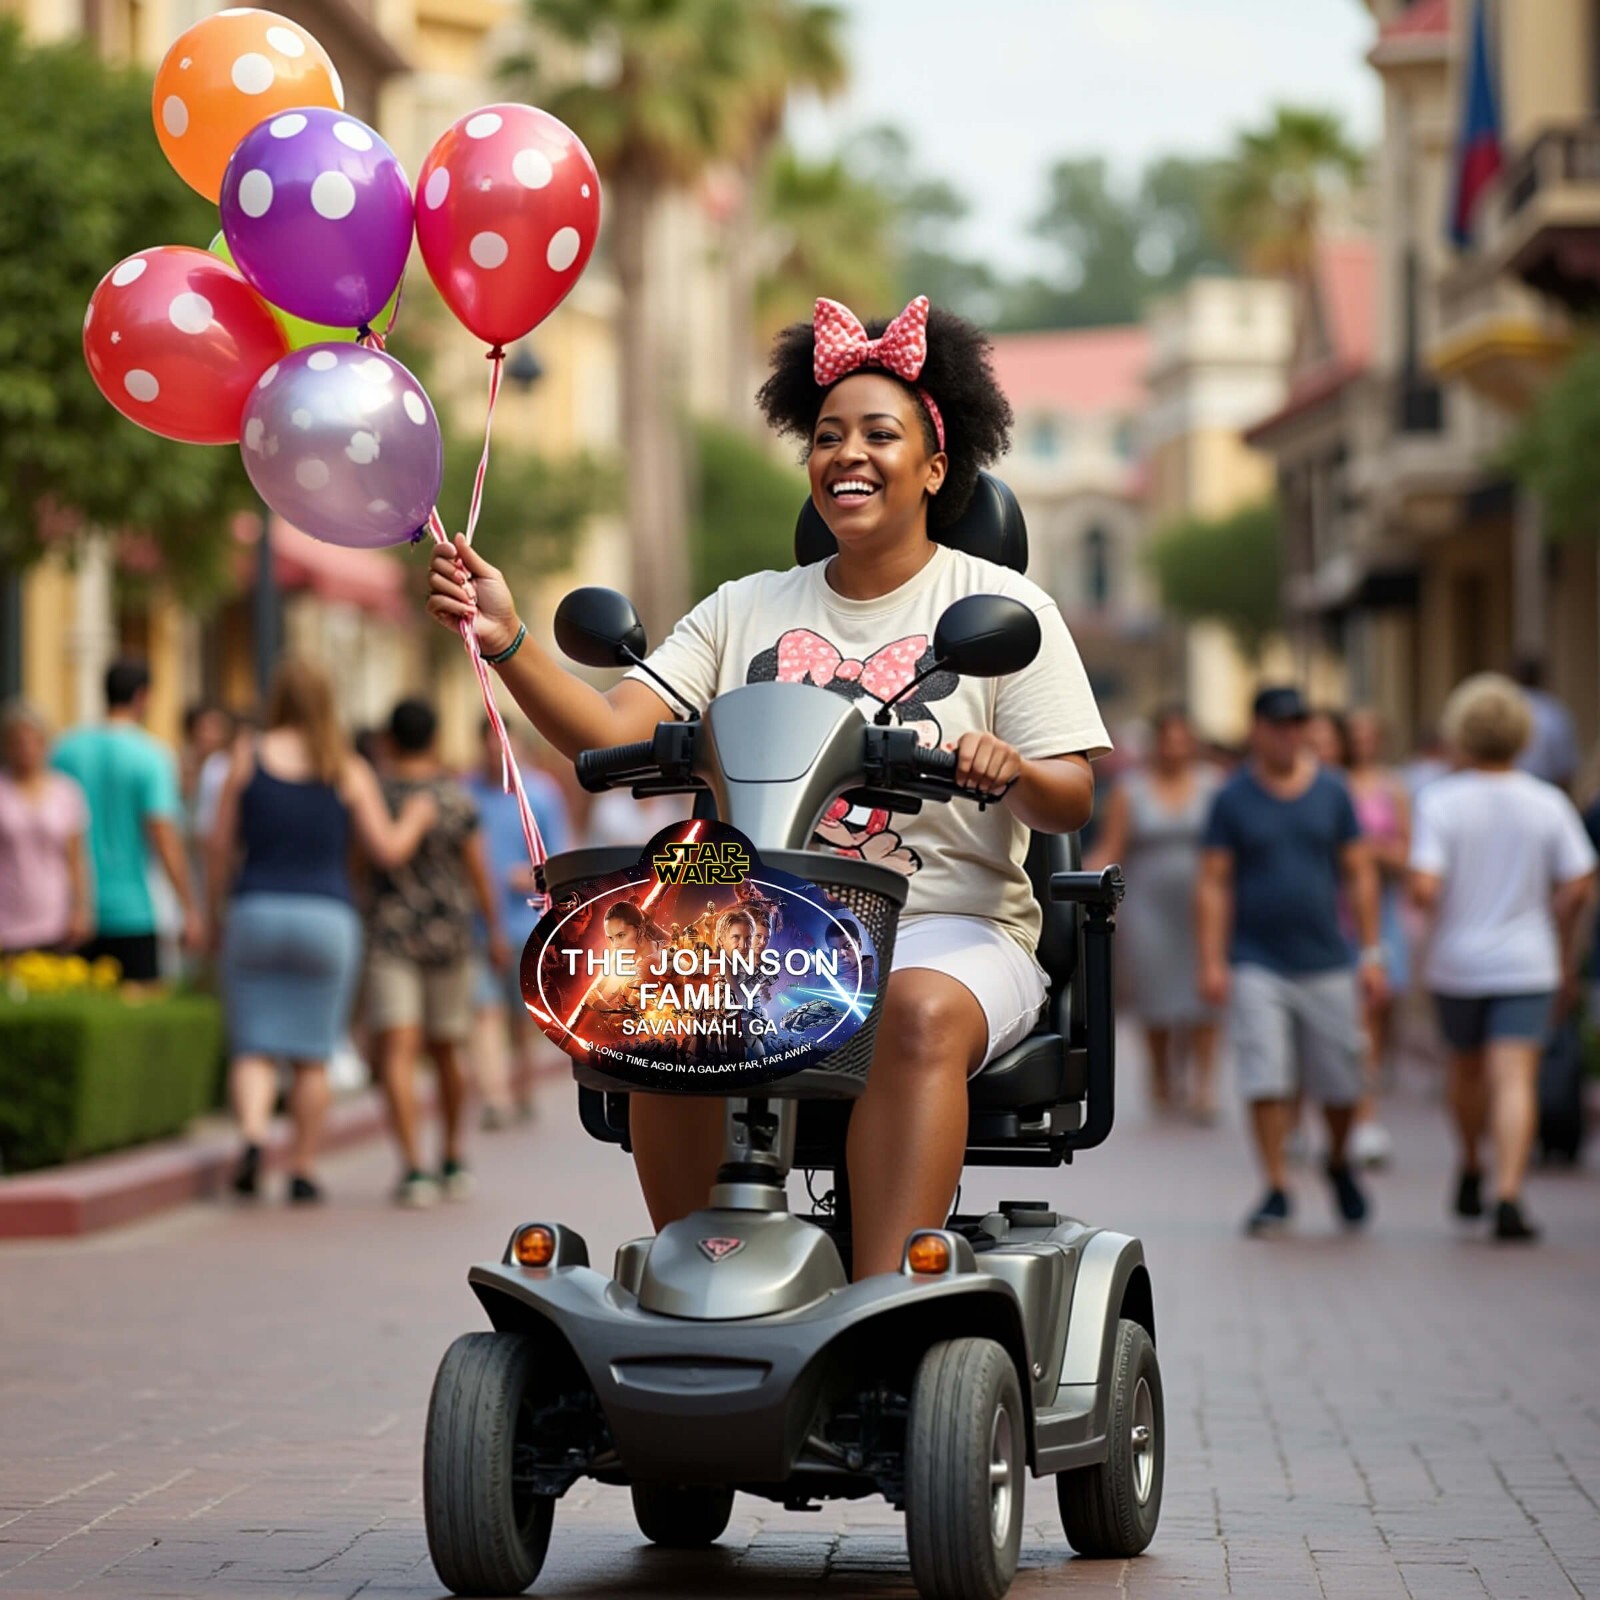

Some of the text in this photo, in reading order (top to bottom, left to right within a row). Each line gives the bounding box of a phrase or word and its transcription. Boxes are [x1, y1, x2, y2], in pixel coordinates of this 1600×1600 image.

[653, 842, 750, 864] STAR
[653, 863, 750, 885] WARS
[561, 948, 839, 977] THE JOHNSON
[639, 983, 762, 1011] FAMILY
[622, 1019, 779, 1037] SAVANNAH, GA
[586, 1041, 812, 1074] A LONG TIME AGO IN A GALAXY FAR, FAR AWAY
